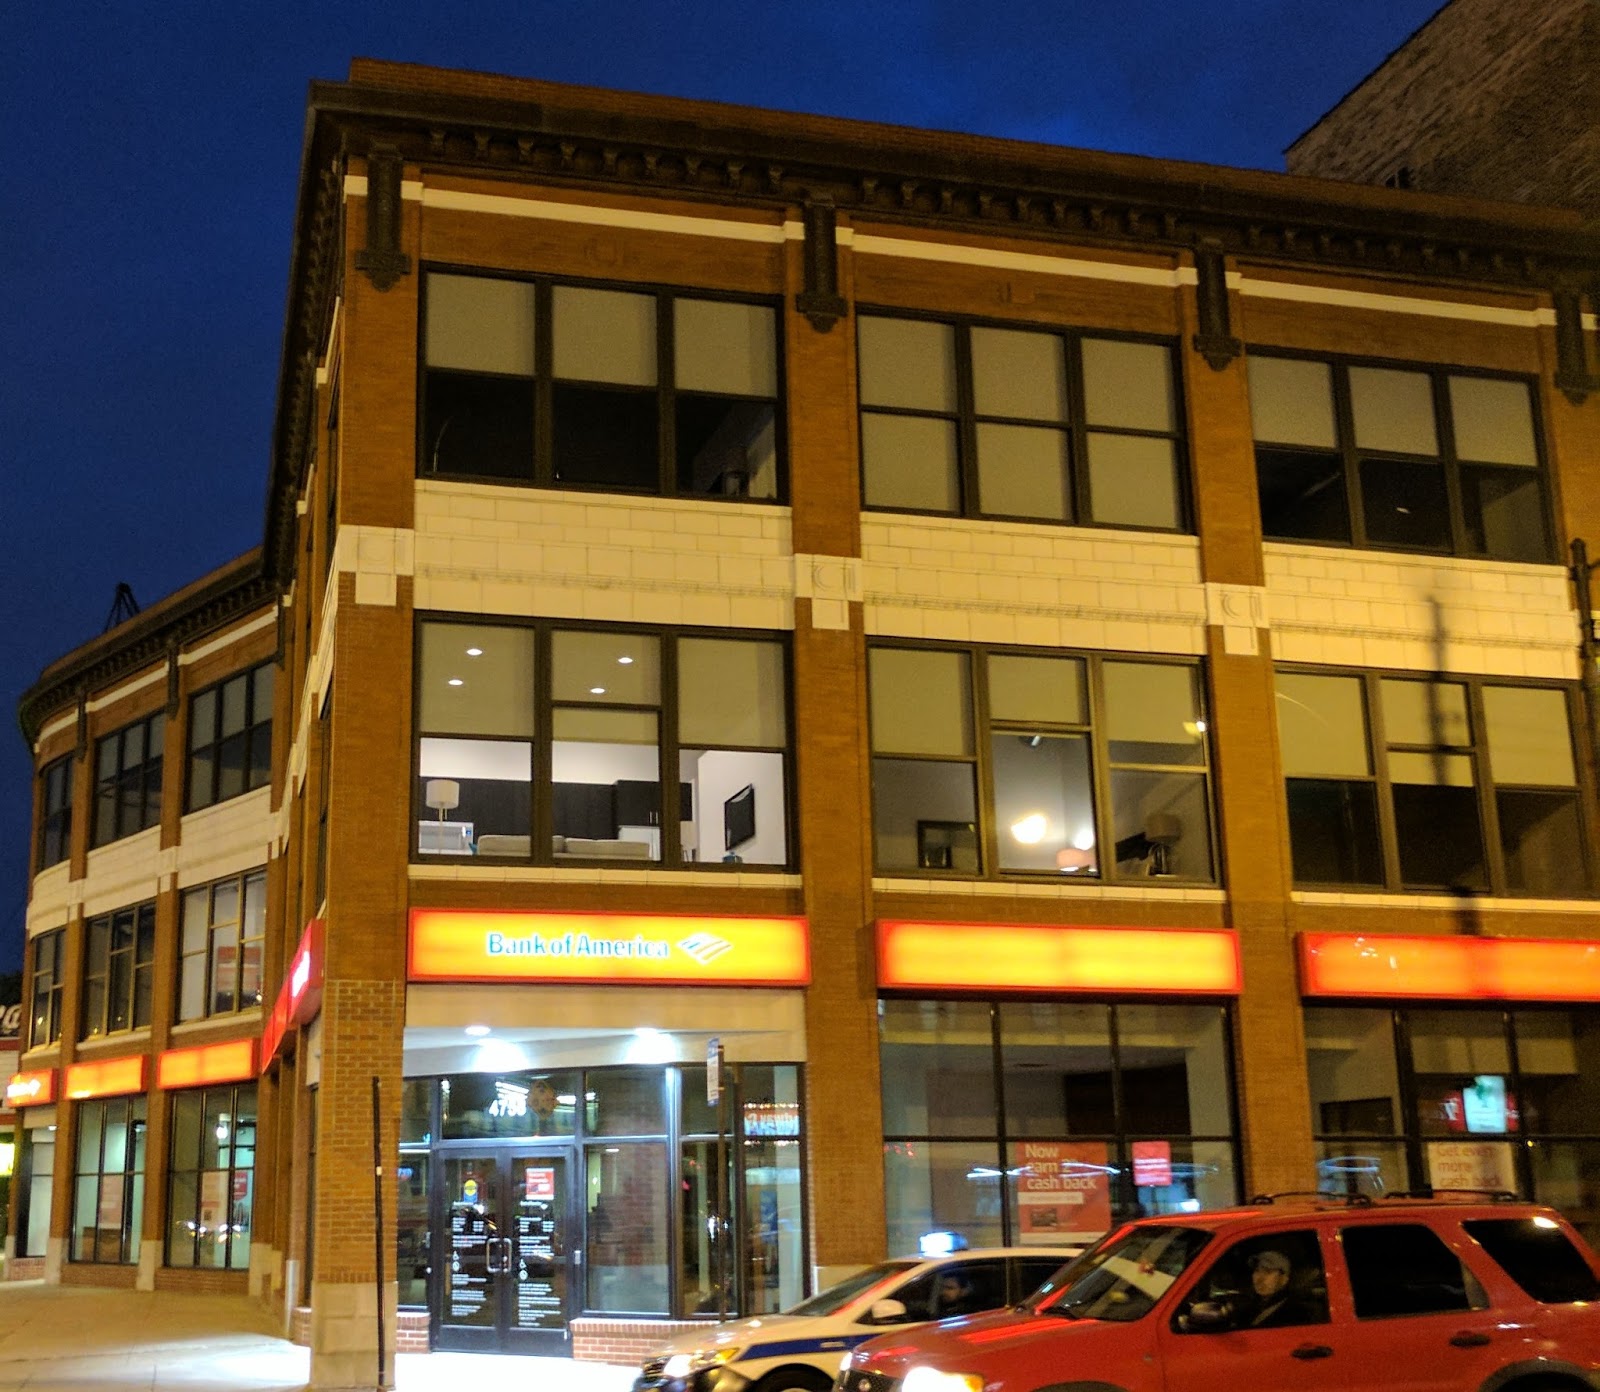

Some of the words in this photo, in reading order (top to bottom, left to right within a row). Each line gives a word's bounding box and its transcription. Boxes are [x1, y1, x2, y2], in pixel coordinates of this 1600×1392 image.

[488, 932, 546, 955] Bank
[550, 934, 572, 955] of
[577, 935, 669, 957] America
[1025, 1144, 1059, 1158] Now
[1026, 1175, 1060, 1190] cash
[1062, 1176, 1097, 1190] back
